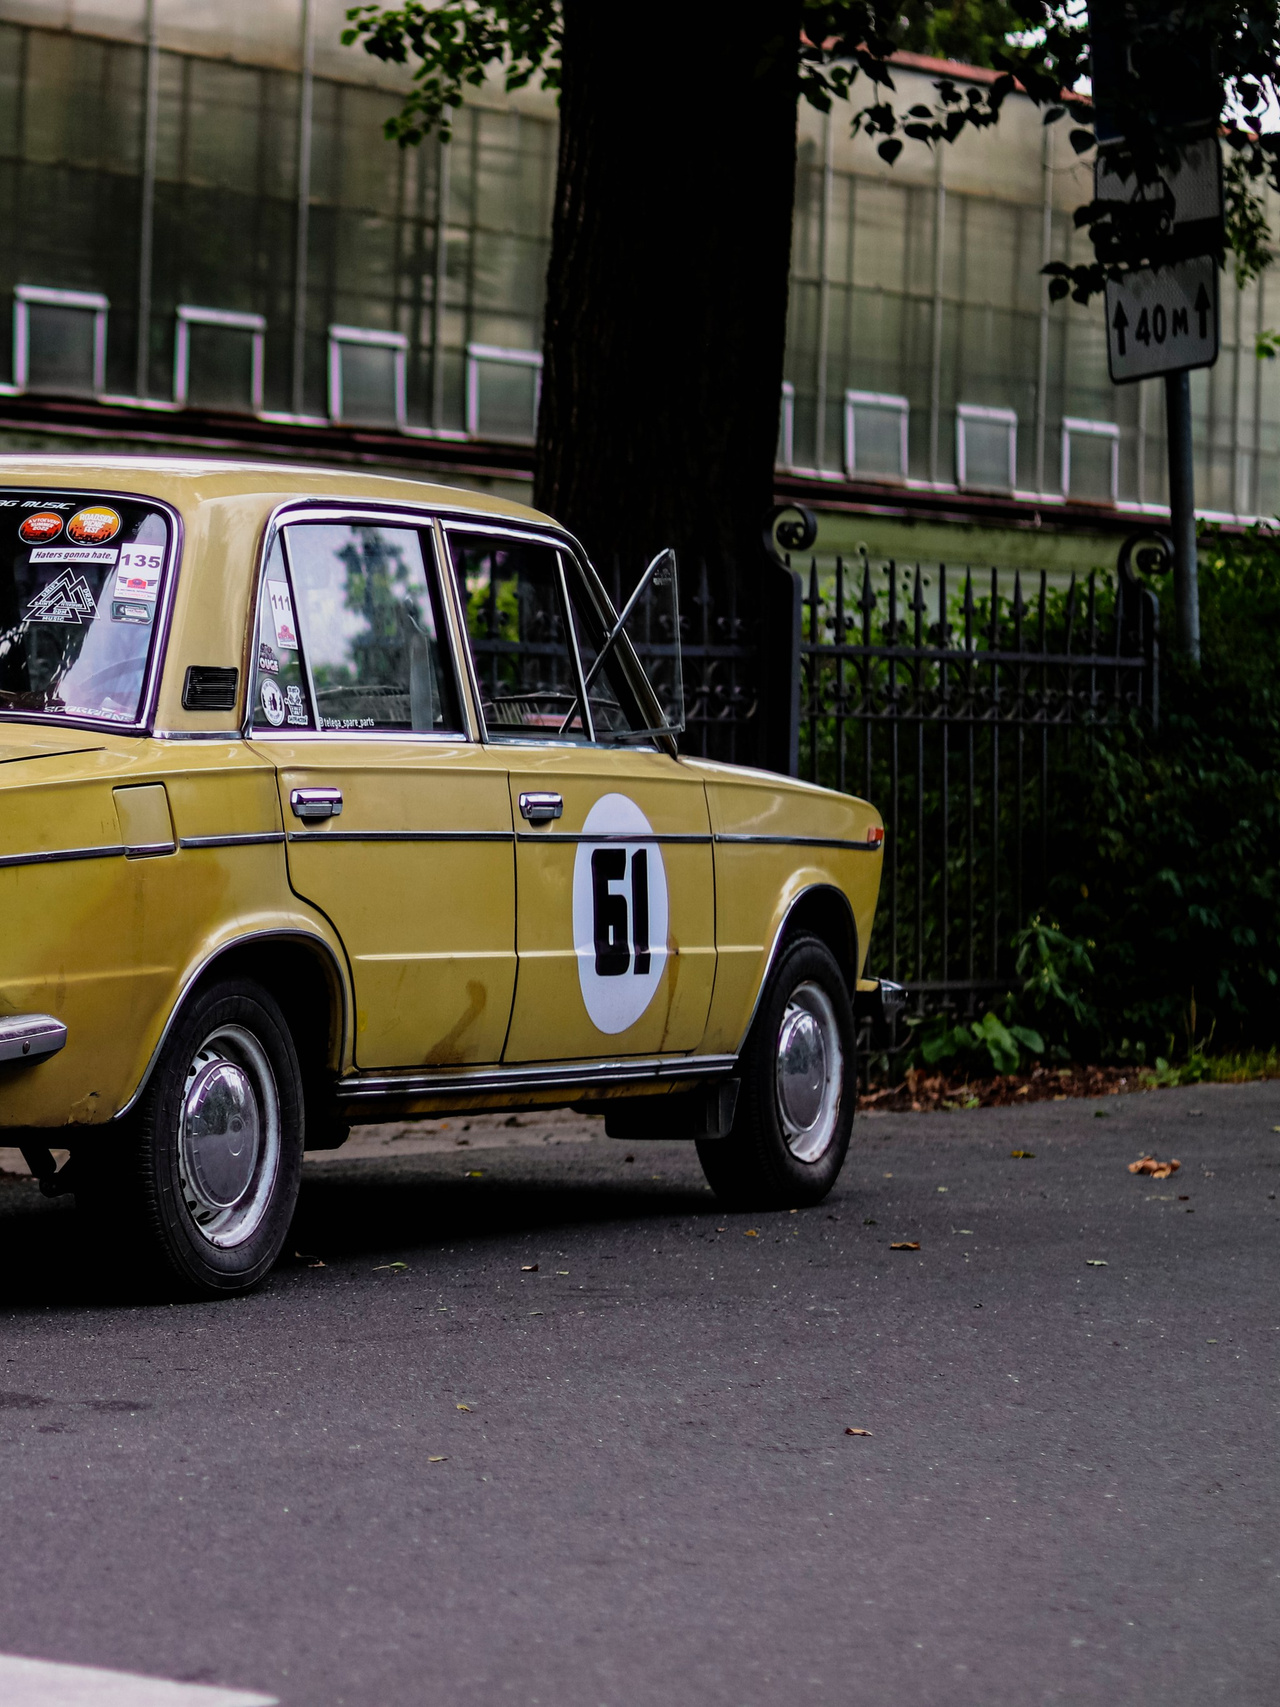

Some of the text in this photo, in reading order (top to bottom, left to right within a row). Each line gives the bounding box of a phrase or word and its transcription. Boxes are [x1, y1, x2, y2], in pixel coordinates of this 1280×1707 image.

[1135, 304, 1167, 347] 40
[20, 500, 76, 510] MUSIC
[79, 513, 115, 524] ROADSIDE
[83, 520, 106, 529] PICNIC
[83, 526, 100, 534] FEST
[34, 551, 113, 560] Haters gonna hate.
[121, 553, 160, 569] 135
[83, 588, 95, 607] DRAG
[271, 594, 291, 611] 111
[591, 848, 651, 976] 61
